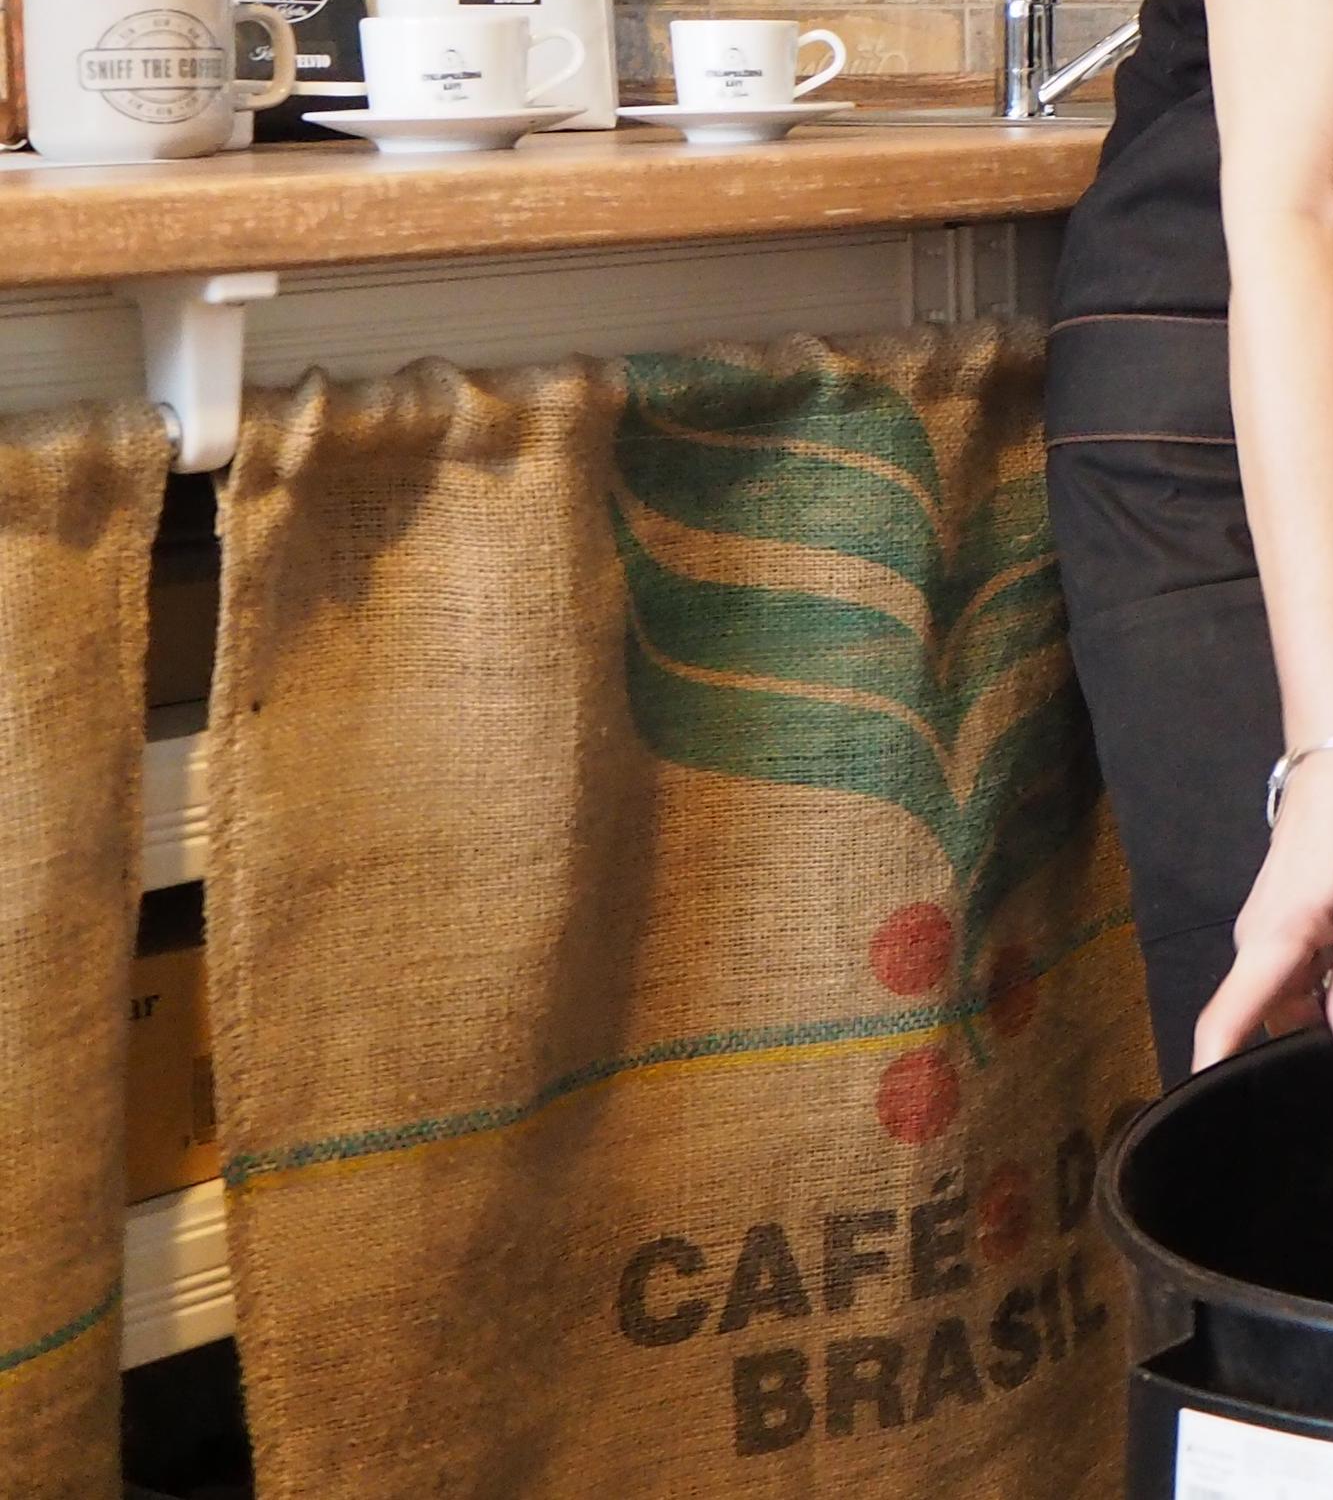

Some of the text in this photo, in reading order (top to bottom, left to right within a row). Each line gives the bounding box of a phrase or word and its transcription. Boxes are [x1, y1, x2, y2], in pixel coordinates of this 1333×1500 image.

[86, 58, 133, 81] SNIFF
[141, 57, 173, 79] THE
[612, 1166, 973, 1349] CAFÉ
[731, 1253, 1109, 1457] BRASIL
